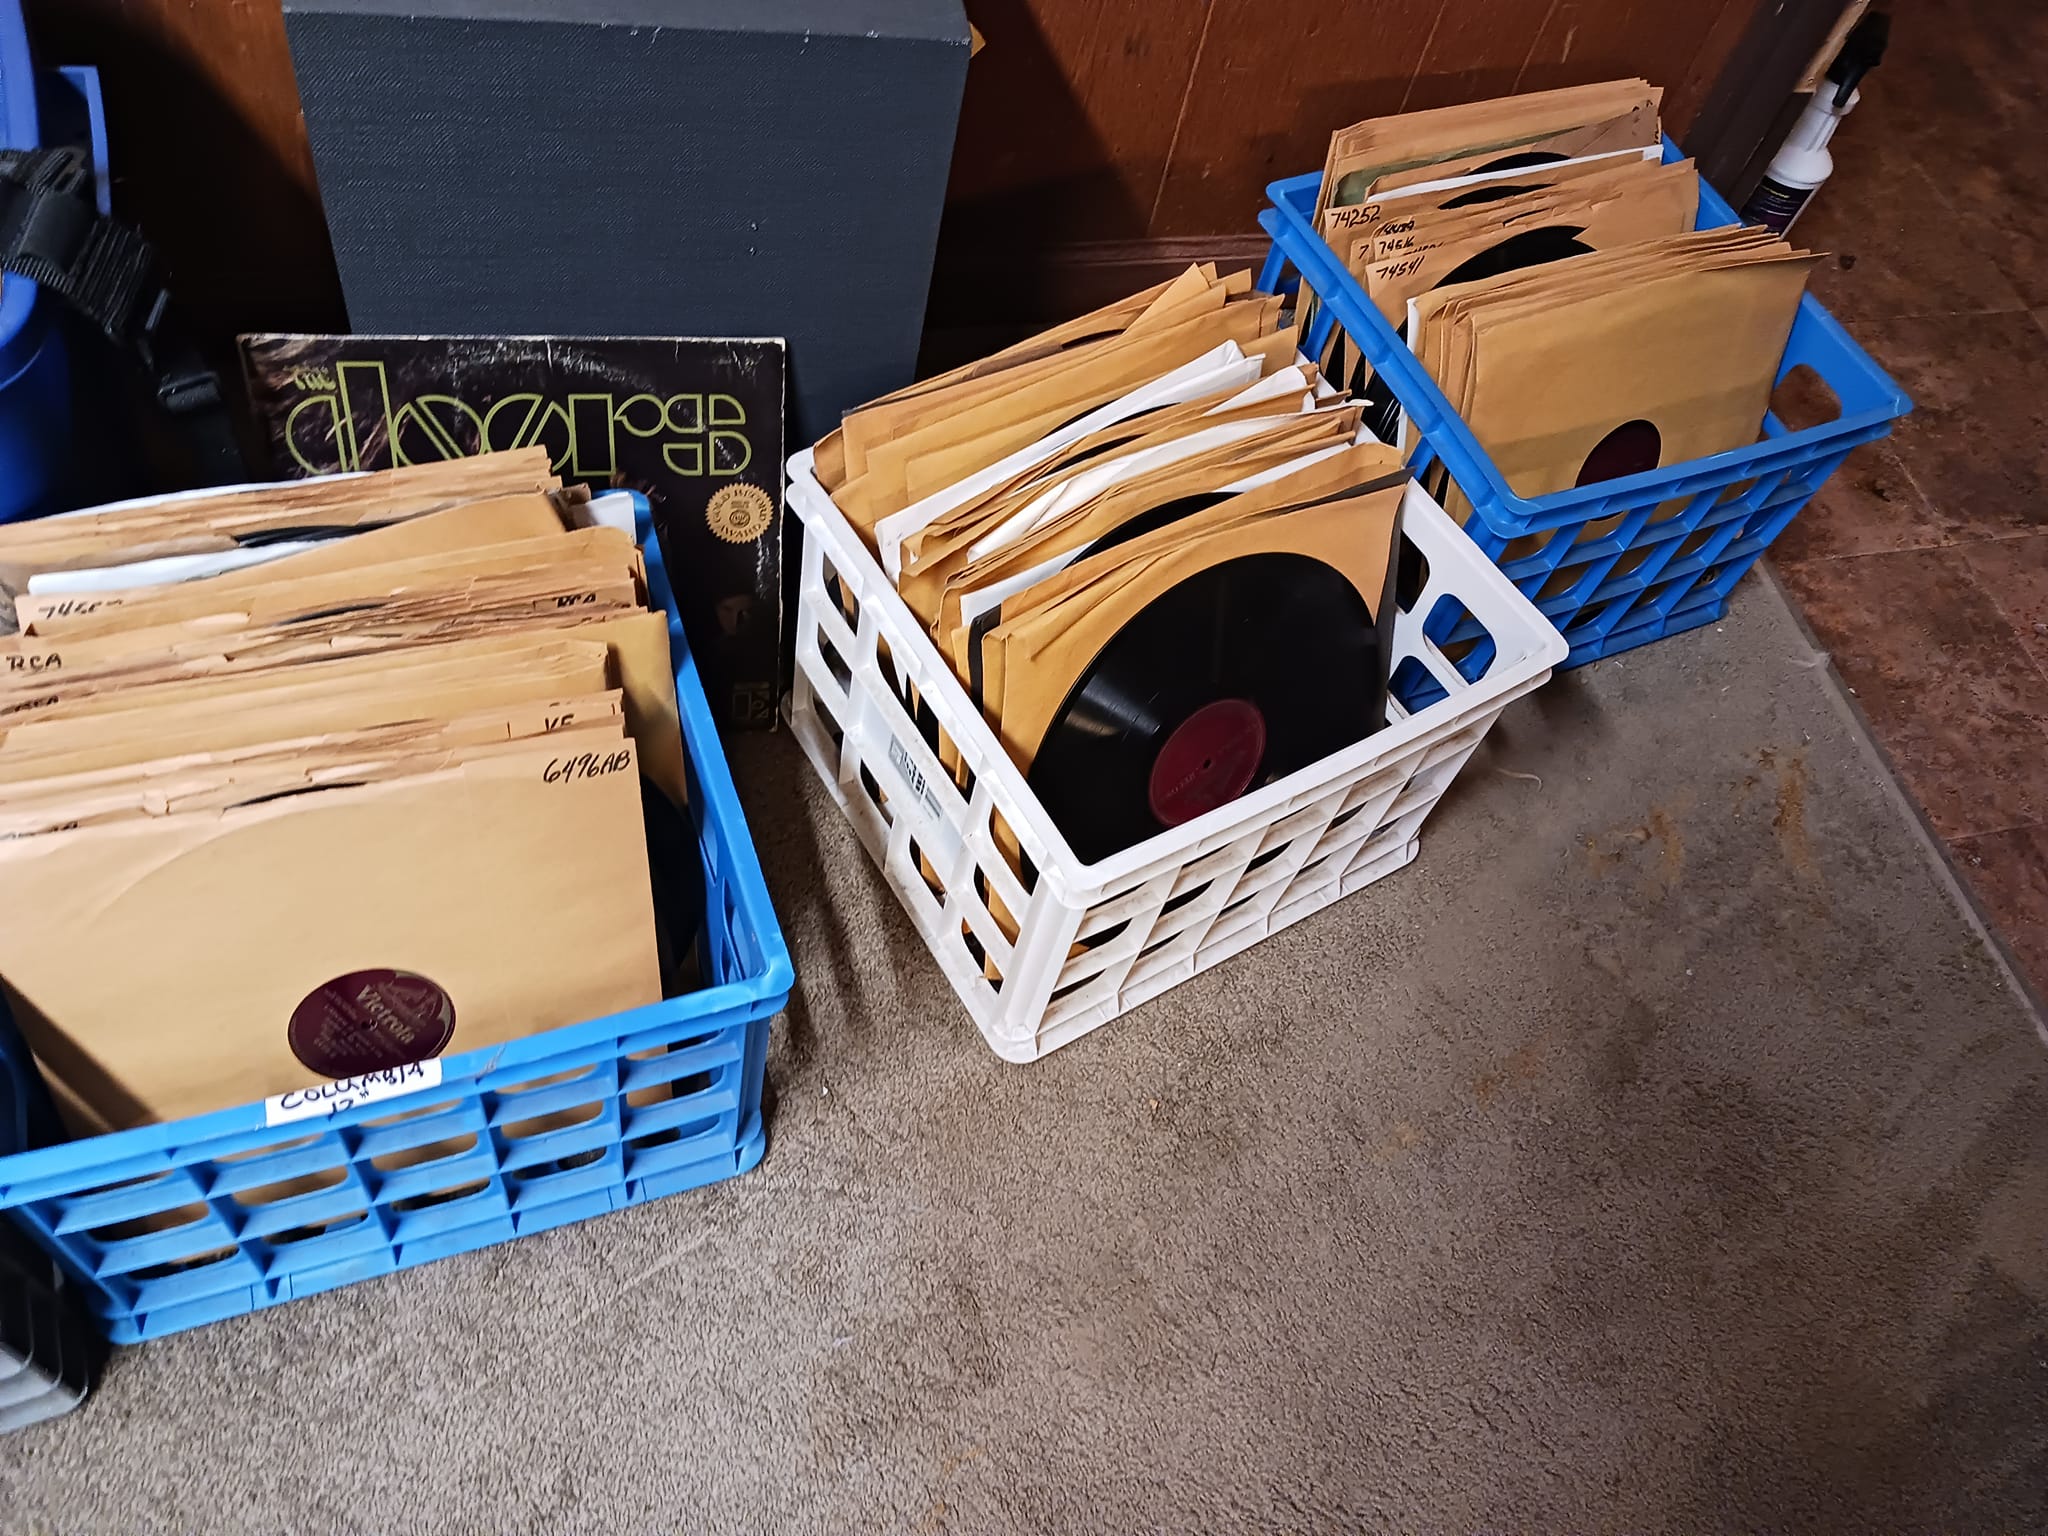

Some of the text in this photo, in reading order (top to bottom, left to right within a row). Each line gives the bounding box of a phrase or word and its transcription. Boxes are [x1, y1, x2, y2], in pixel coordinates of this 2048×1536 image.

[1331, 205, 1381, 229] 74252
[1376, 255, 1425, 280] 74541
[734, 489, 767, 522] RECORD
[720, 523, 762, 538] AWARD
[6, 652, 62, 672] RCA
[543, 750, 631, 784] 6496AB
[356, 983, 416, 1044] Victrola
[280, 1060, 425, 1110] COLUMBIA
